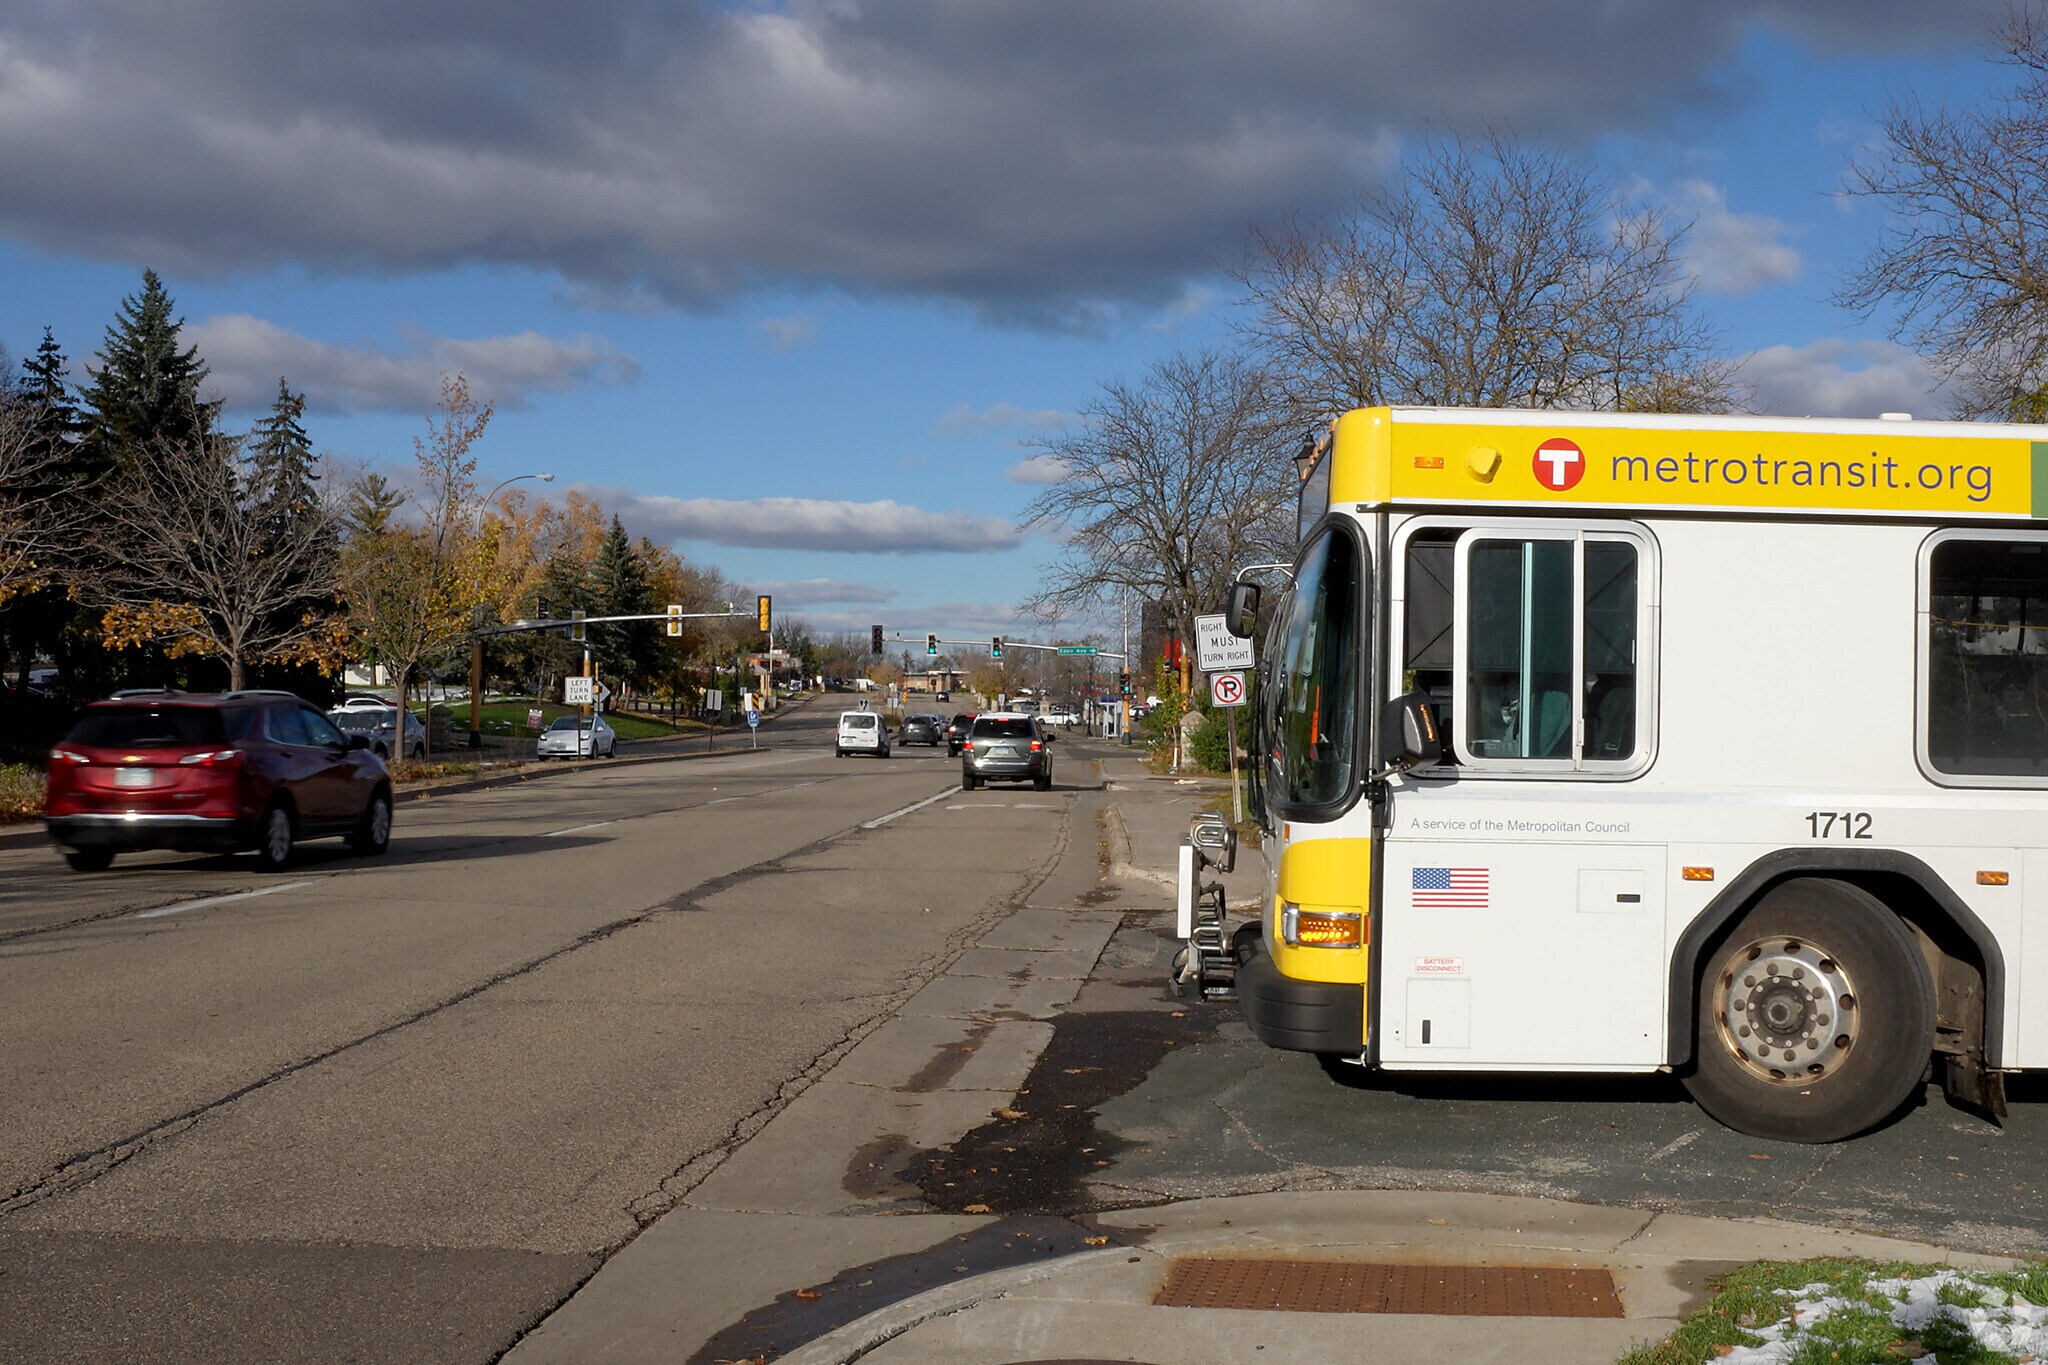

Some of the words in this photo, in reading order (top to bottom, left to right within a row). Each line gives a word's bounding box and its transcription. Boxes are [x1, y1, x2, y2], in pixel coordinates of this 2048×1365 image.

[1611, 450, 1992, 502] metrotransit.org
[1201, 623, 1222, 632] RIGHT
[1204, 654, 1223, 662] TURN
[1228, 651, 1249, 660] RIGHT
[1411, 818, 1420, 829] A
[1423, 819, 1465, 830] service
[1470, 819, 1482, 830] of
[1485, 820, 1503, 831] the
[1507, 820, 1581, 834] Metropolitan
[1586, 821, 1630, 833] Council
[1805, 812, 1873, 839] 1712
